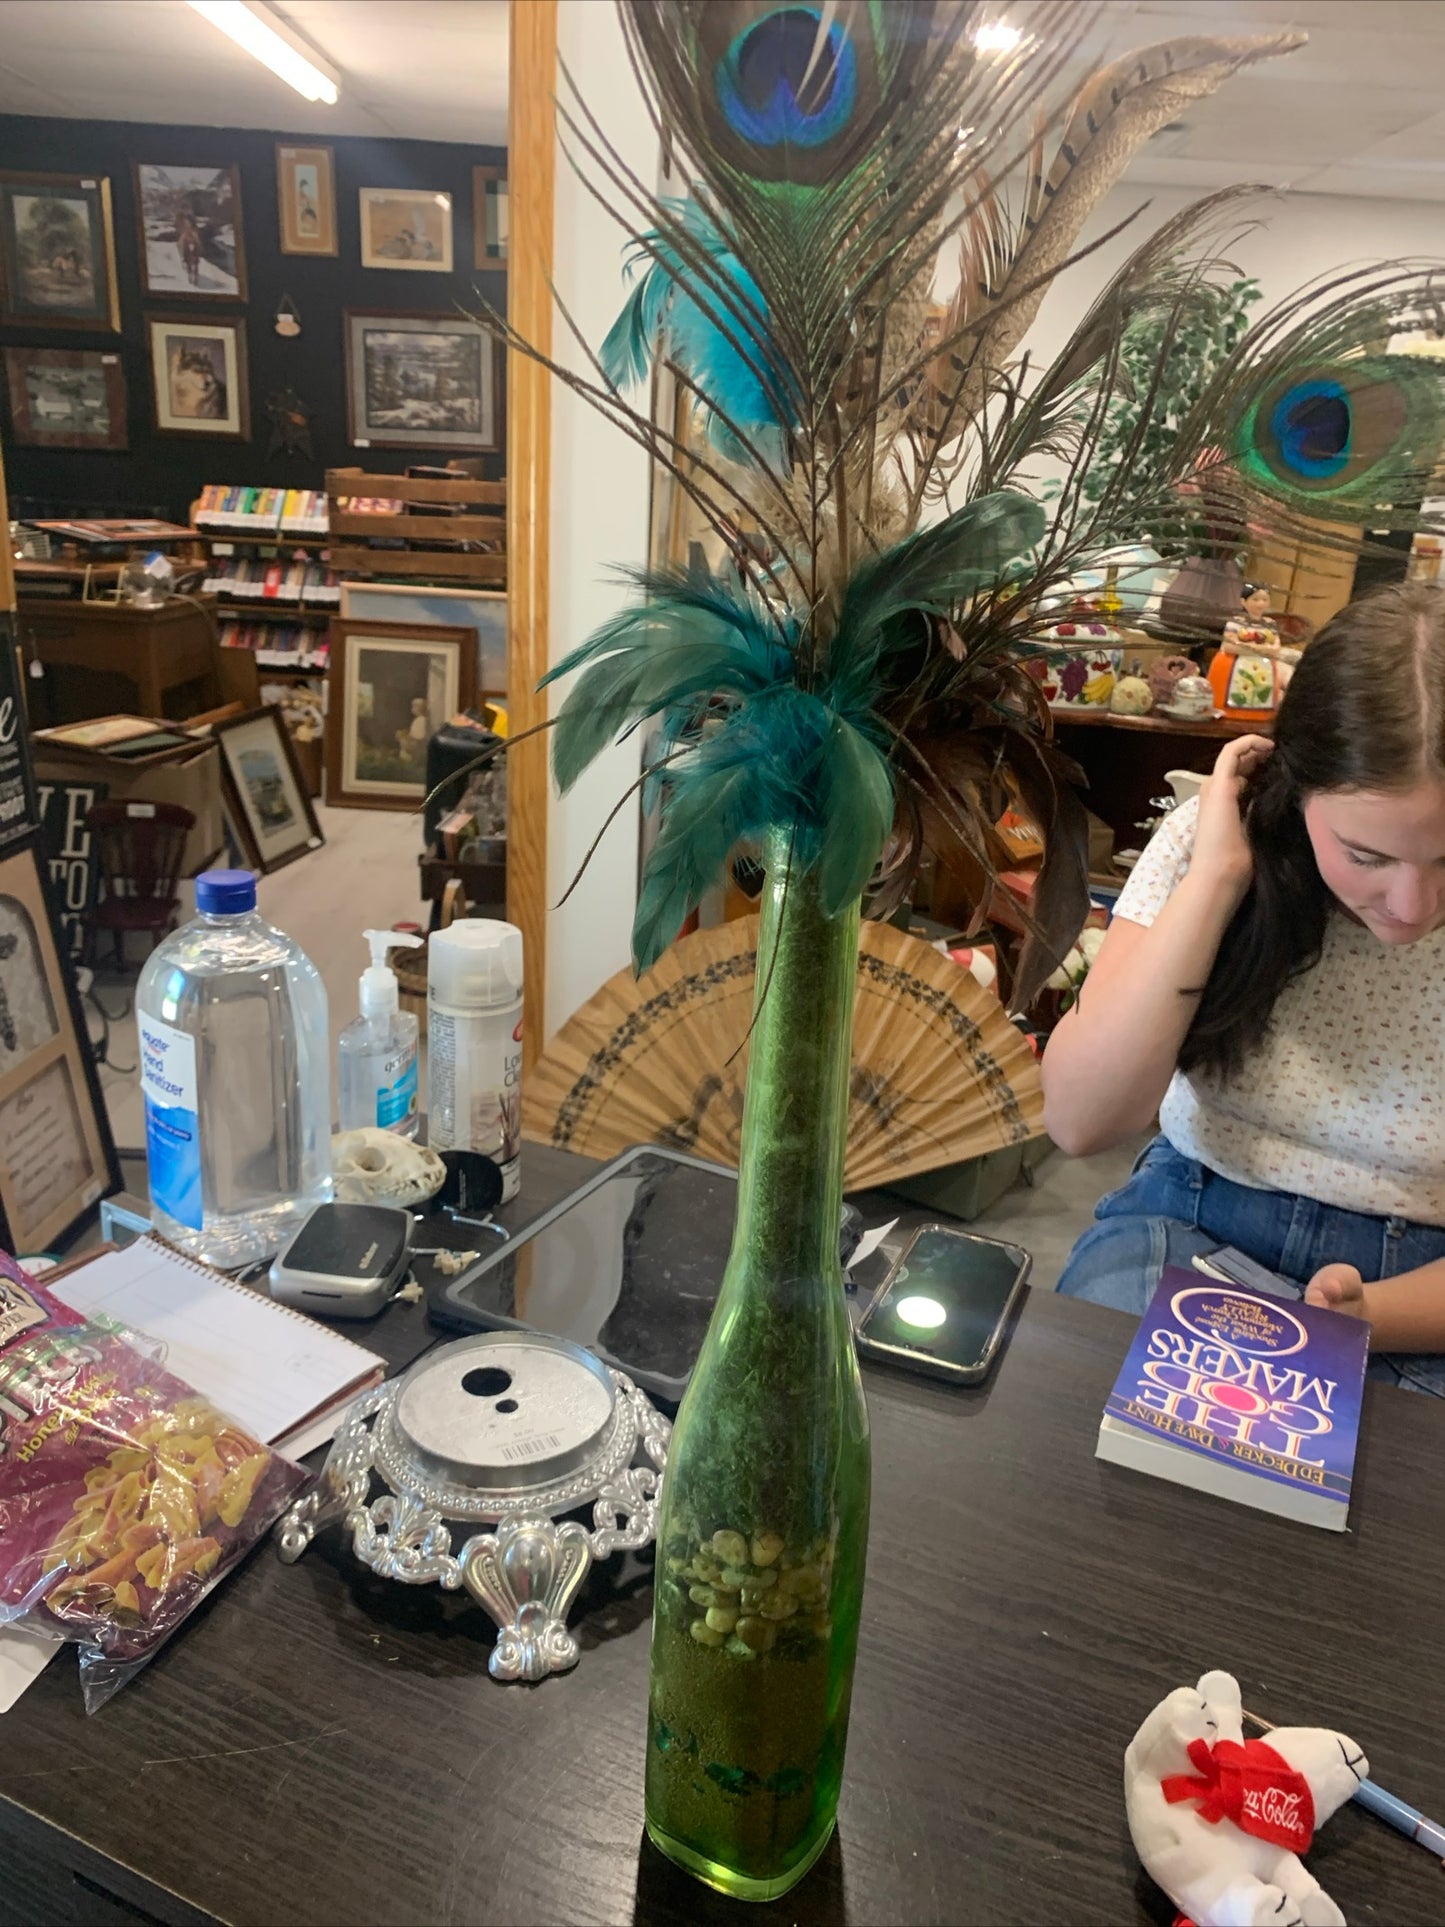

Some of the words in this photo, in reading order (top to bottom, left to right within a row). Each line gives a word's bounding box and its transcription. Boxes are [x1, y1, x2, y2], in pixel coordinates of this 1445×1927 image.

[1147, 1328, 1338, 1414] MAKERS
[1143, 1361, 1333, 1434] GOD
[1123, 1401, 1172, 1432] HUNT
[1136, 1380, 1325, 1468] THE
[1174, 1423, 1214, 1448] DAVE
[1217, 1436, 1229, 1450] &
[1233, 1443, 1299, 1481] DECKER
[1300, 1466, 1325, 1486] ED
